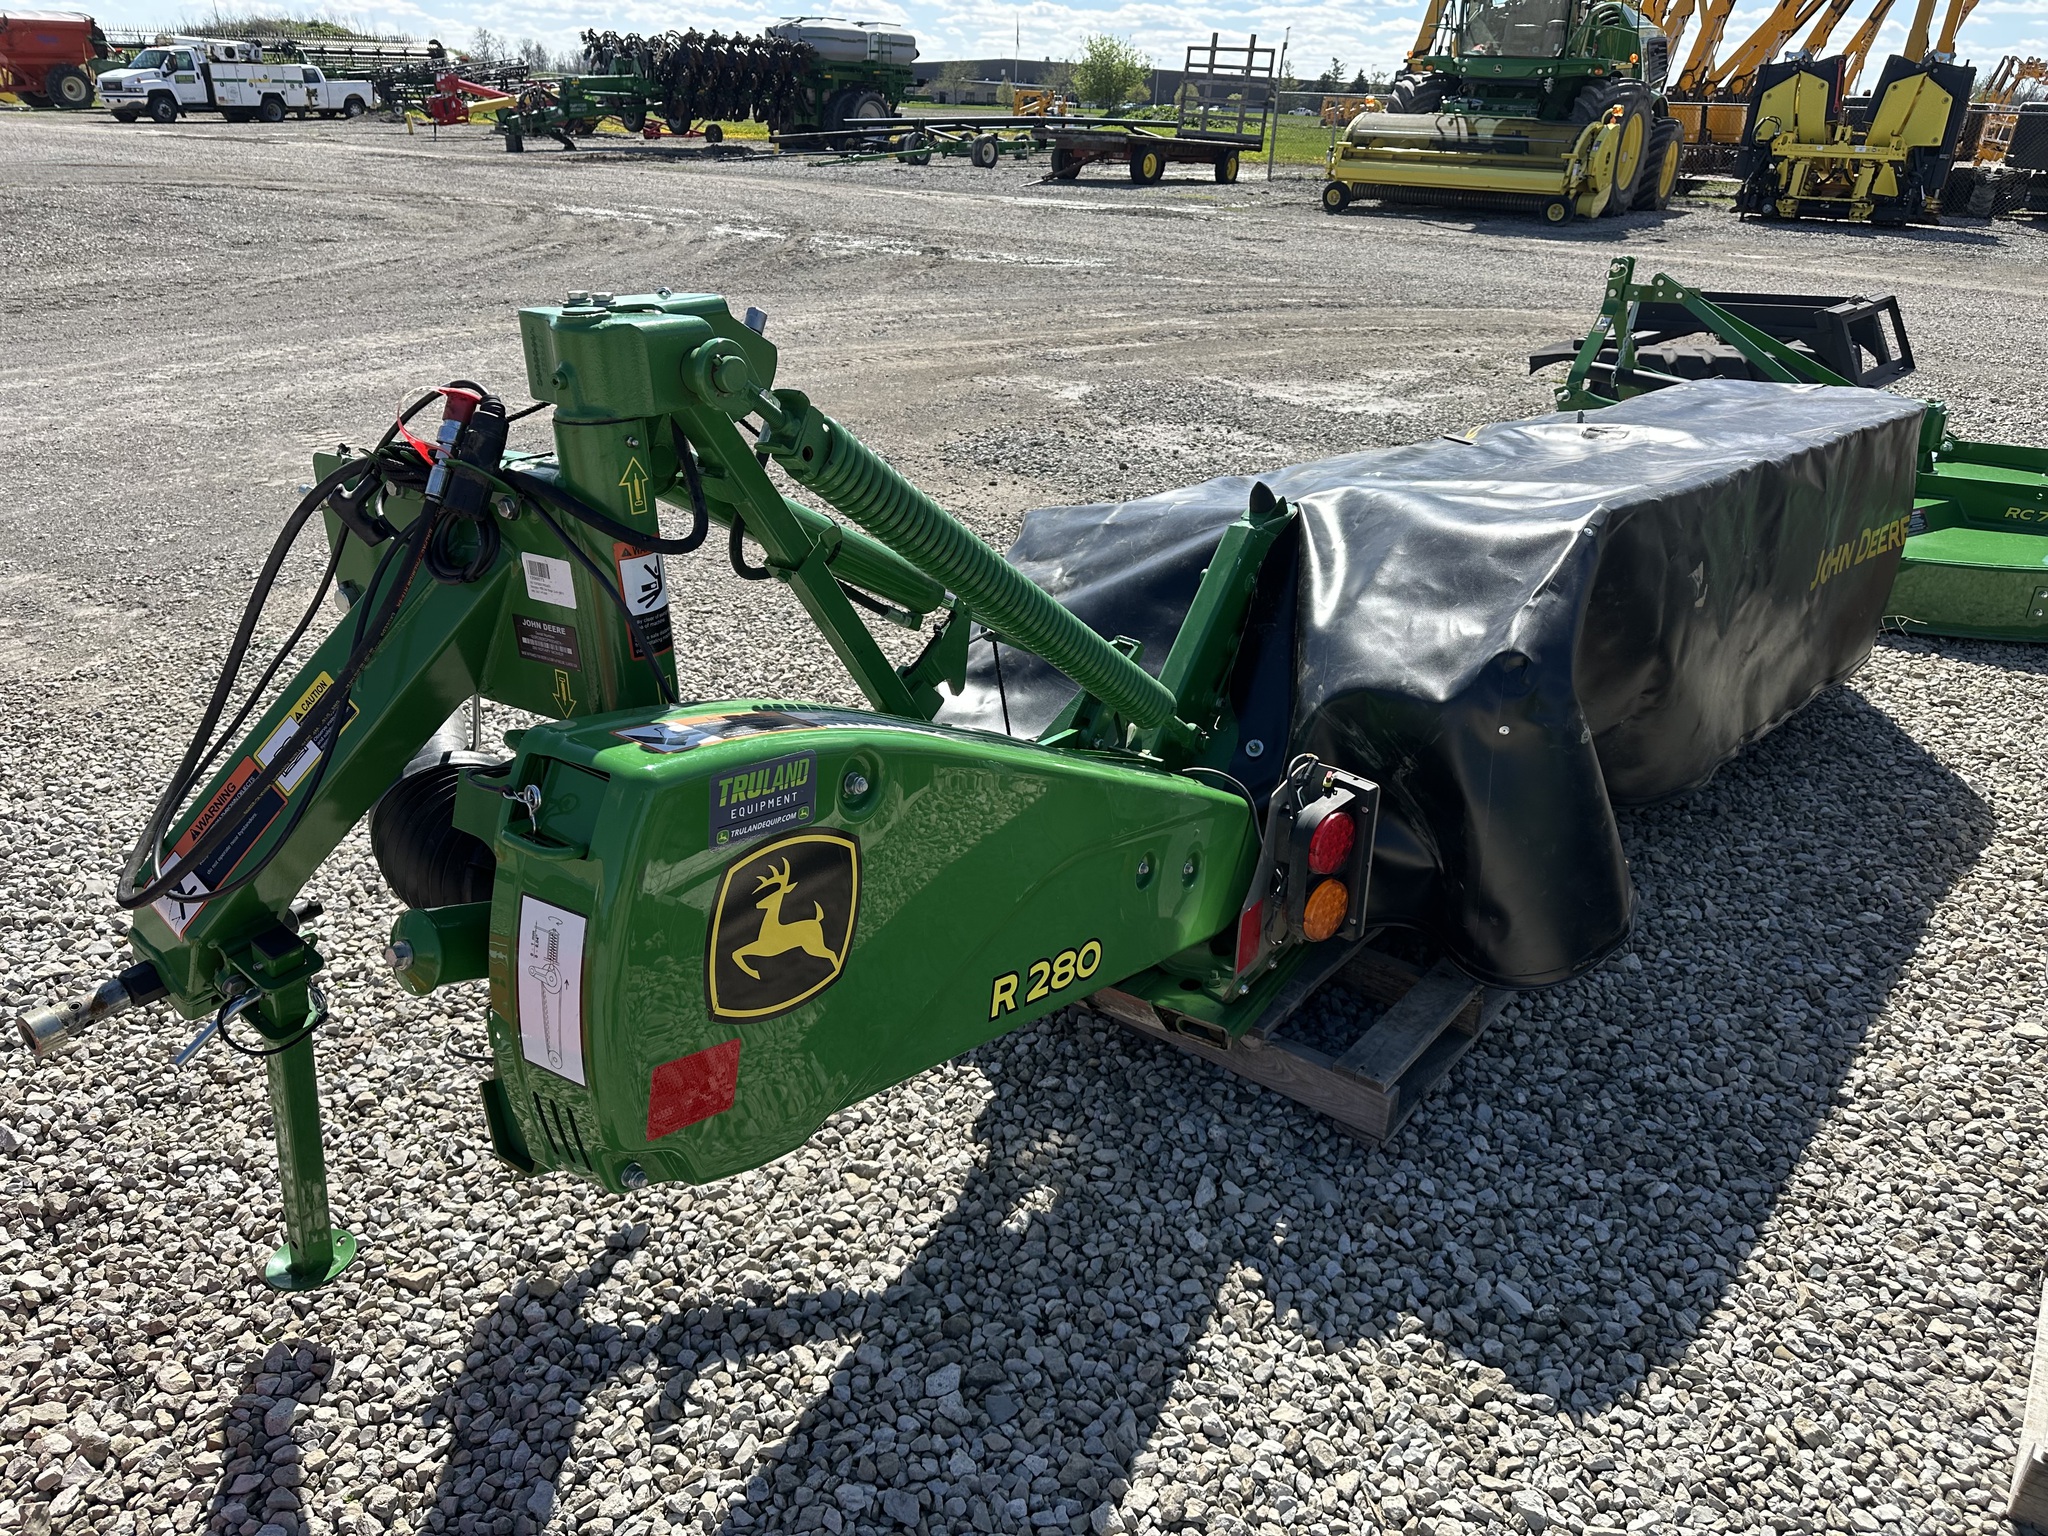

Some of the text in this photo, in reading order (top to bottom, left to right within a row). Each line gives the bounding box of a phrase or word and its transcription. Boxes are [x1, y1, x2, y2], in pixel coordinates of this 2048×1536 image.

[2004, 506, 2036, 521] RC
[1810, 540, 1856, 591] JOHN
[522, 619, 566, 635] JOHN DEERE
[301, 680, 328, 711] CAUTION
[719, 758, 810, 807] TRULAND
[196, 782, 236, 831] WARNING
[731, 792, 798, 819] EQUIPMENT
[731, 811, 797, 837] TRULANDEQUIP.COM
[990, 939, 1102, 1020] R 280
